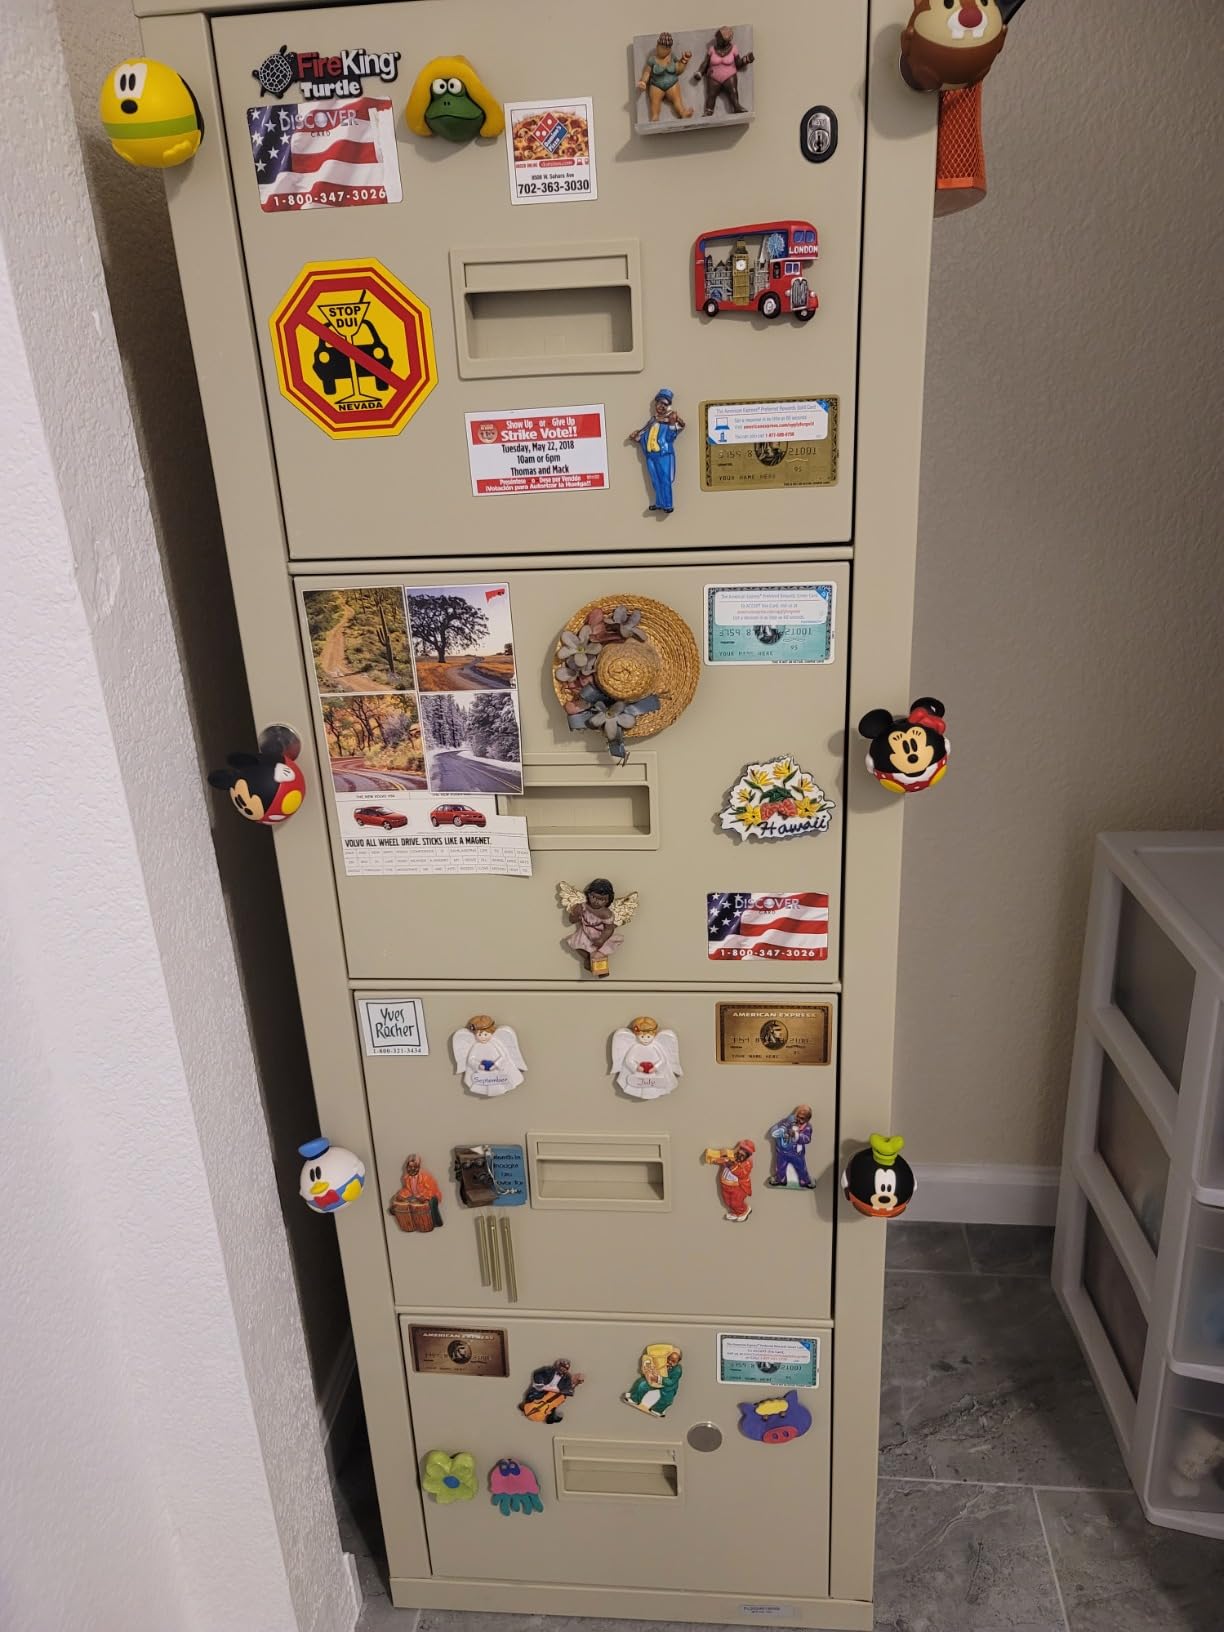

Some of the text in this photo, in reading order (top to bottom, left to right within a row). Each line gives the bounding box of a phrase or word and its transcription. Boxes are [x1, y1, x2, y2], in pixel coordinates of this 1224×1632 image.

[297, 49, 398, 80] FireKing
[301, 79, 361, 97] Turtle
[279, 109, 359, 131] DISCOVER
[518, 179, 590, 195] 702-363-3030
[273, 188, 386, 206] 1-800-347-3026
[789, 245, 818, 254] LONDON
[329, 305, 361, 317] STOP
[336, 317, 358, 328] DUI
[338, 401, 383, 411] NEVADA
[506, 420, 522, 430] Show
[524, 419, 533, 429] Up
[551, 417, 565, 427] Give
[566, 417, 576, 426] Up
[500, 427, 577, 441] Strike Vote!!
[501, 441, 575, 454] Tuesday, May 22, 2018
[517, 455, 535, 465] 10am
[545, 454, 561, 465] 6pm
[510, 464, 569, 476] Thomas and Mack
[757, 815, 827, 836] Hawaii
[345, 839, 365, 848] VOLVO
[366, 839, 377, 847] ALL
[378, 838, 400, 847] WHEEL
[422, 837, 443, 846] STICKS
[444, 837, 458, 845] LIKE
[459, 837, 464, 845] A
[465, 836, 492, 845] MAGNET.
[734, 897, 801, 909] DISCOVER
[720, 949, 815, 957] 1-800-347-3026
[380, 1008, 405, 1025] Yves
[473, 1076, 508, 1085] September
[637, 1078, 657, 1088] July
